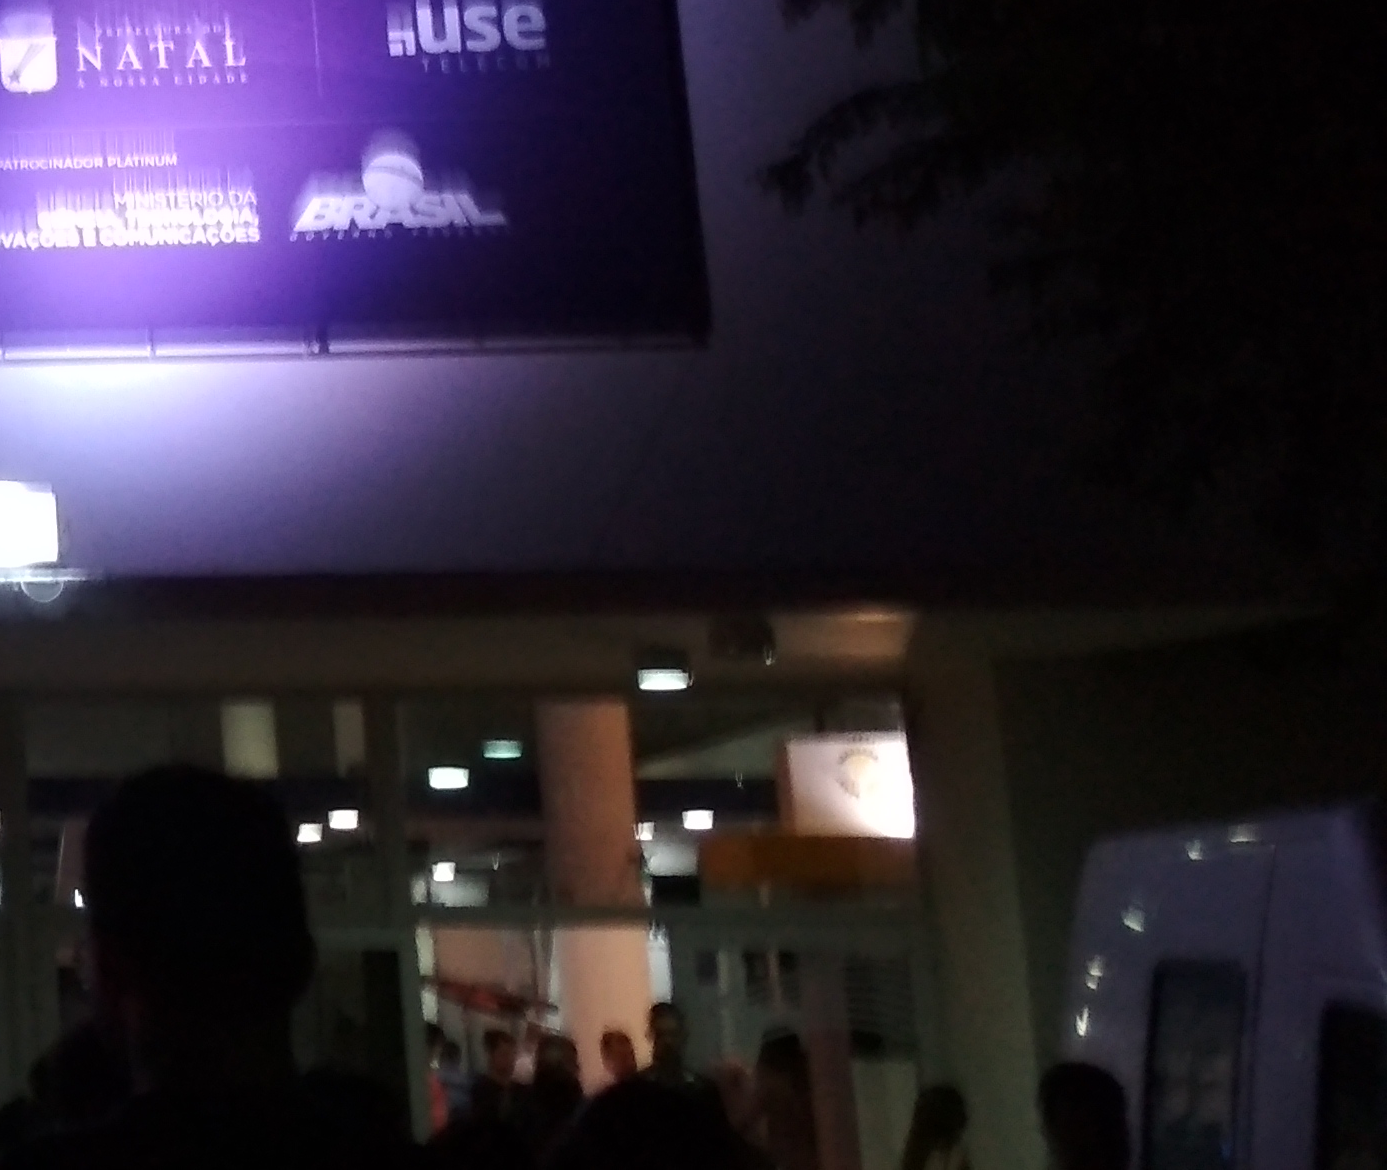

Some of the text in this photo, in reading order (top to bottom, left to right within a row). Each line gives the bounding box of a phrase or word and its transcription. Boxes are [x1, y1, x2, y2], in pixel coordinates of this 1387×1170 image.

[76, 39, 247, 72] NATAL
[107, 153, 178, 168] PLATINUM
[114, 187, 224, 210] MINISTÉRIO
[293, 192, 508, 232] BRASIL
